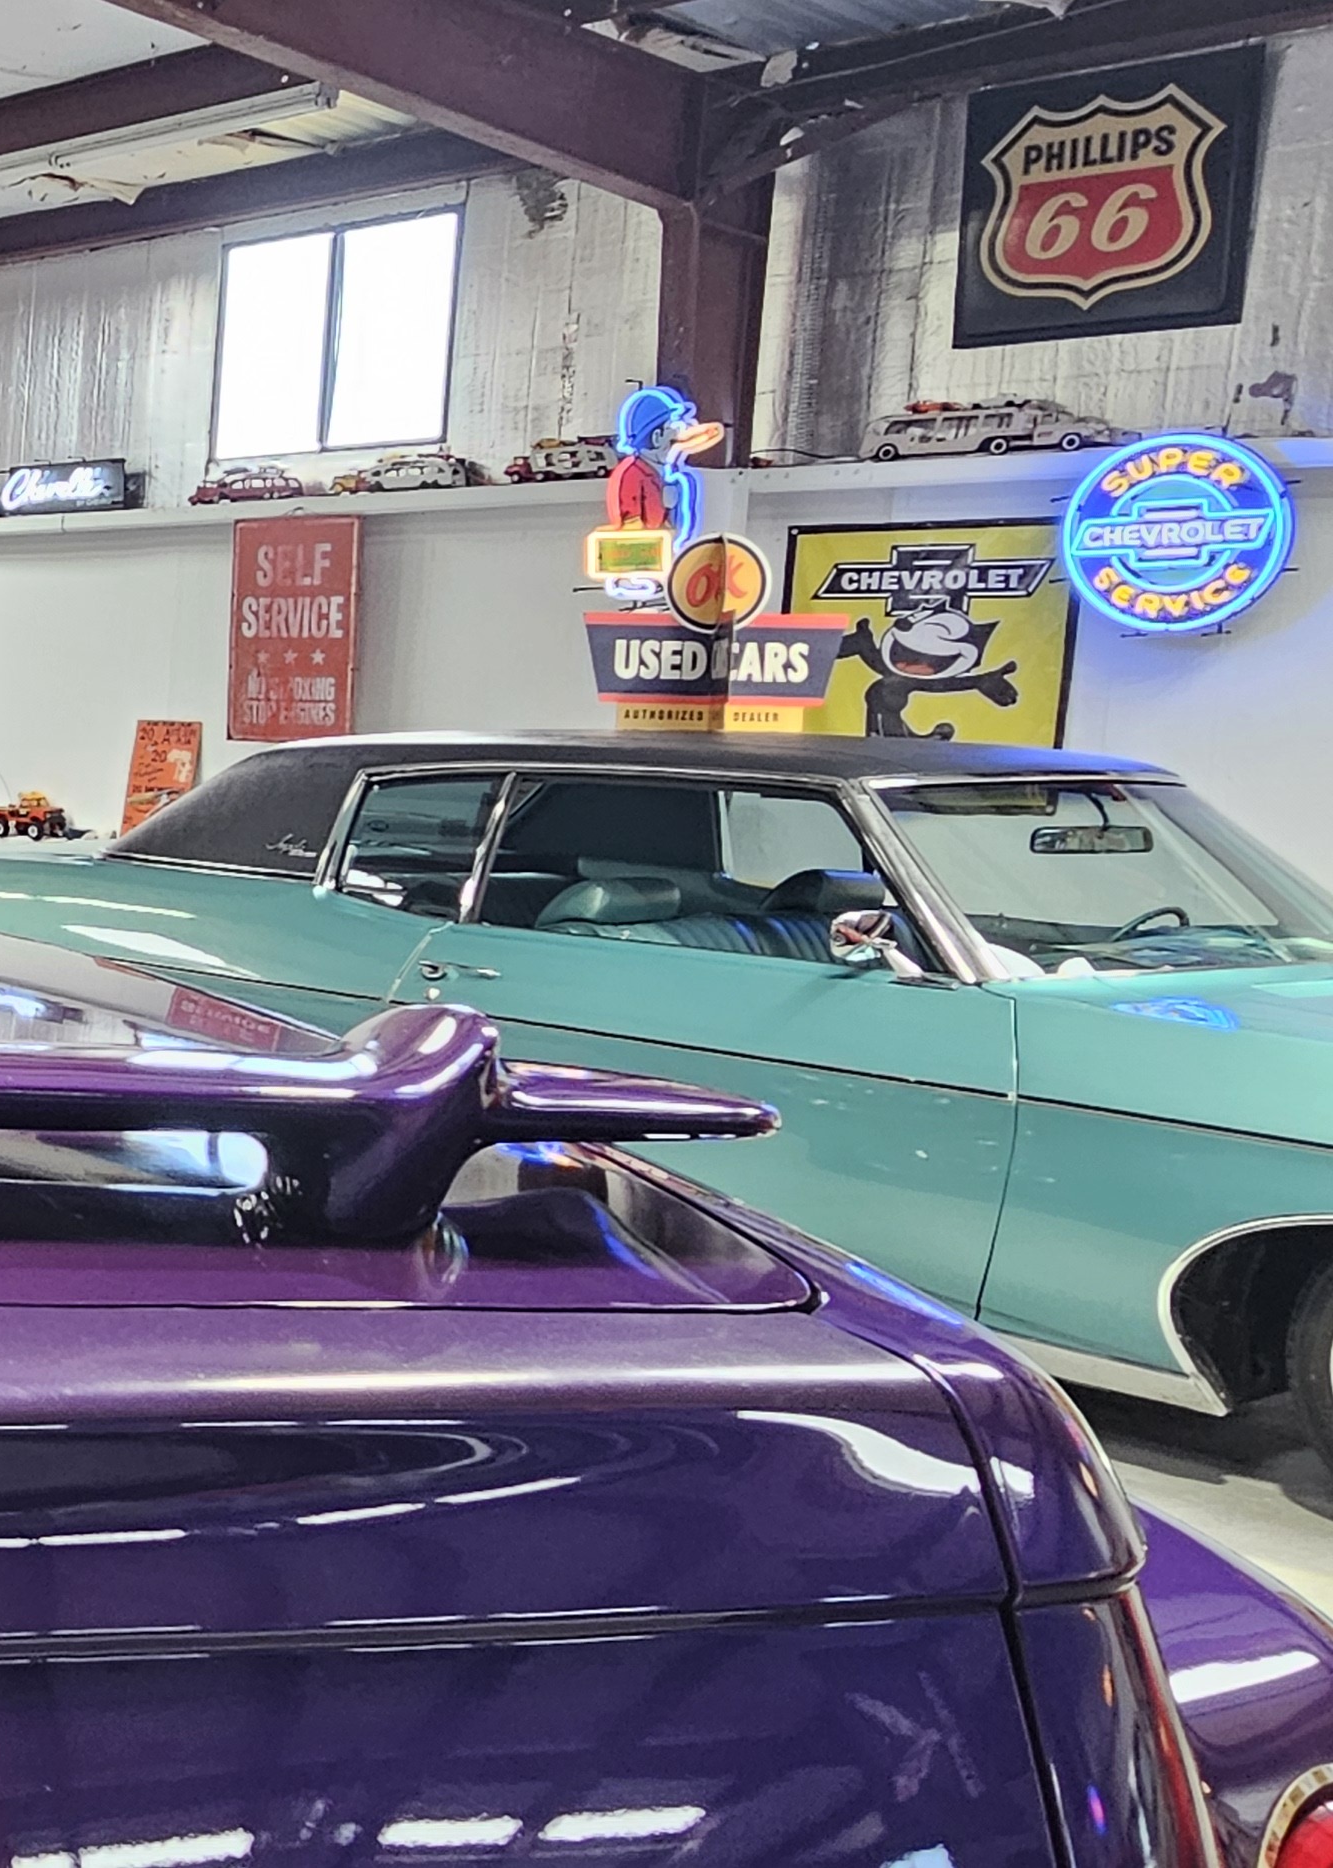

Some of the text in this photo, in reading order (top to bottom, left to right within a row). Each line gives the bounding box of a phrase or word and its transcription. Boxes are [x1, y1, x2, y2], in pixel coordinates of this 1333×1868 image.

[1022, 124, 1177, 176] PHILLIPS
[1025, 183, 1158, 260] 66
[1101, 447, 1244, 497] SUPER
[1082, 517, 1265, 548] CHEVROLET
[256, 543, 331, 586] SELF
[686, 554, 748, 608] OK
[841, 568, 1024, 592] CHEVROLET
[1093, 563, 1252, 619] SERVICE
[241, 596, 345, 639] SERVICE
[614, 637, 810, 684] USED CARS
[623, 708, 780, 723] AUTHORIZED DEALER
